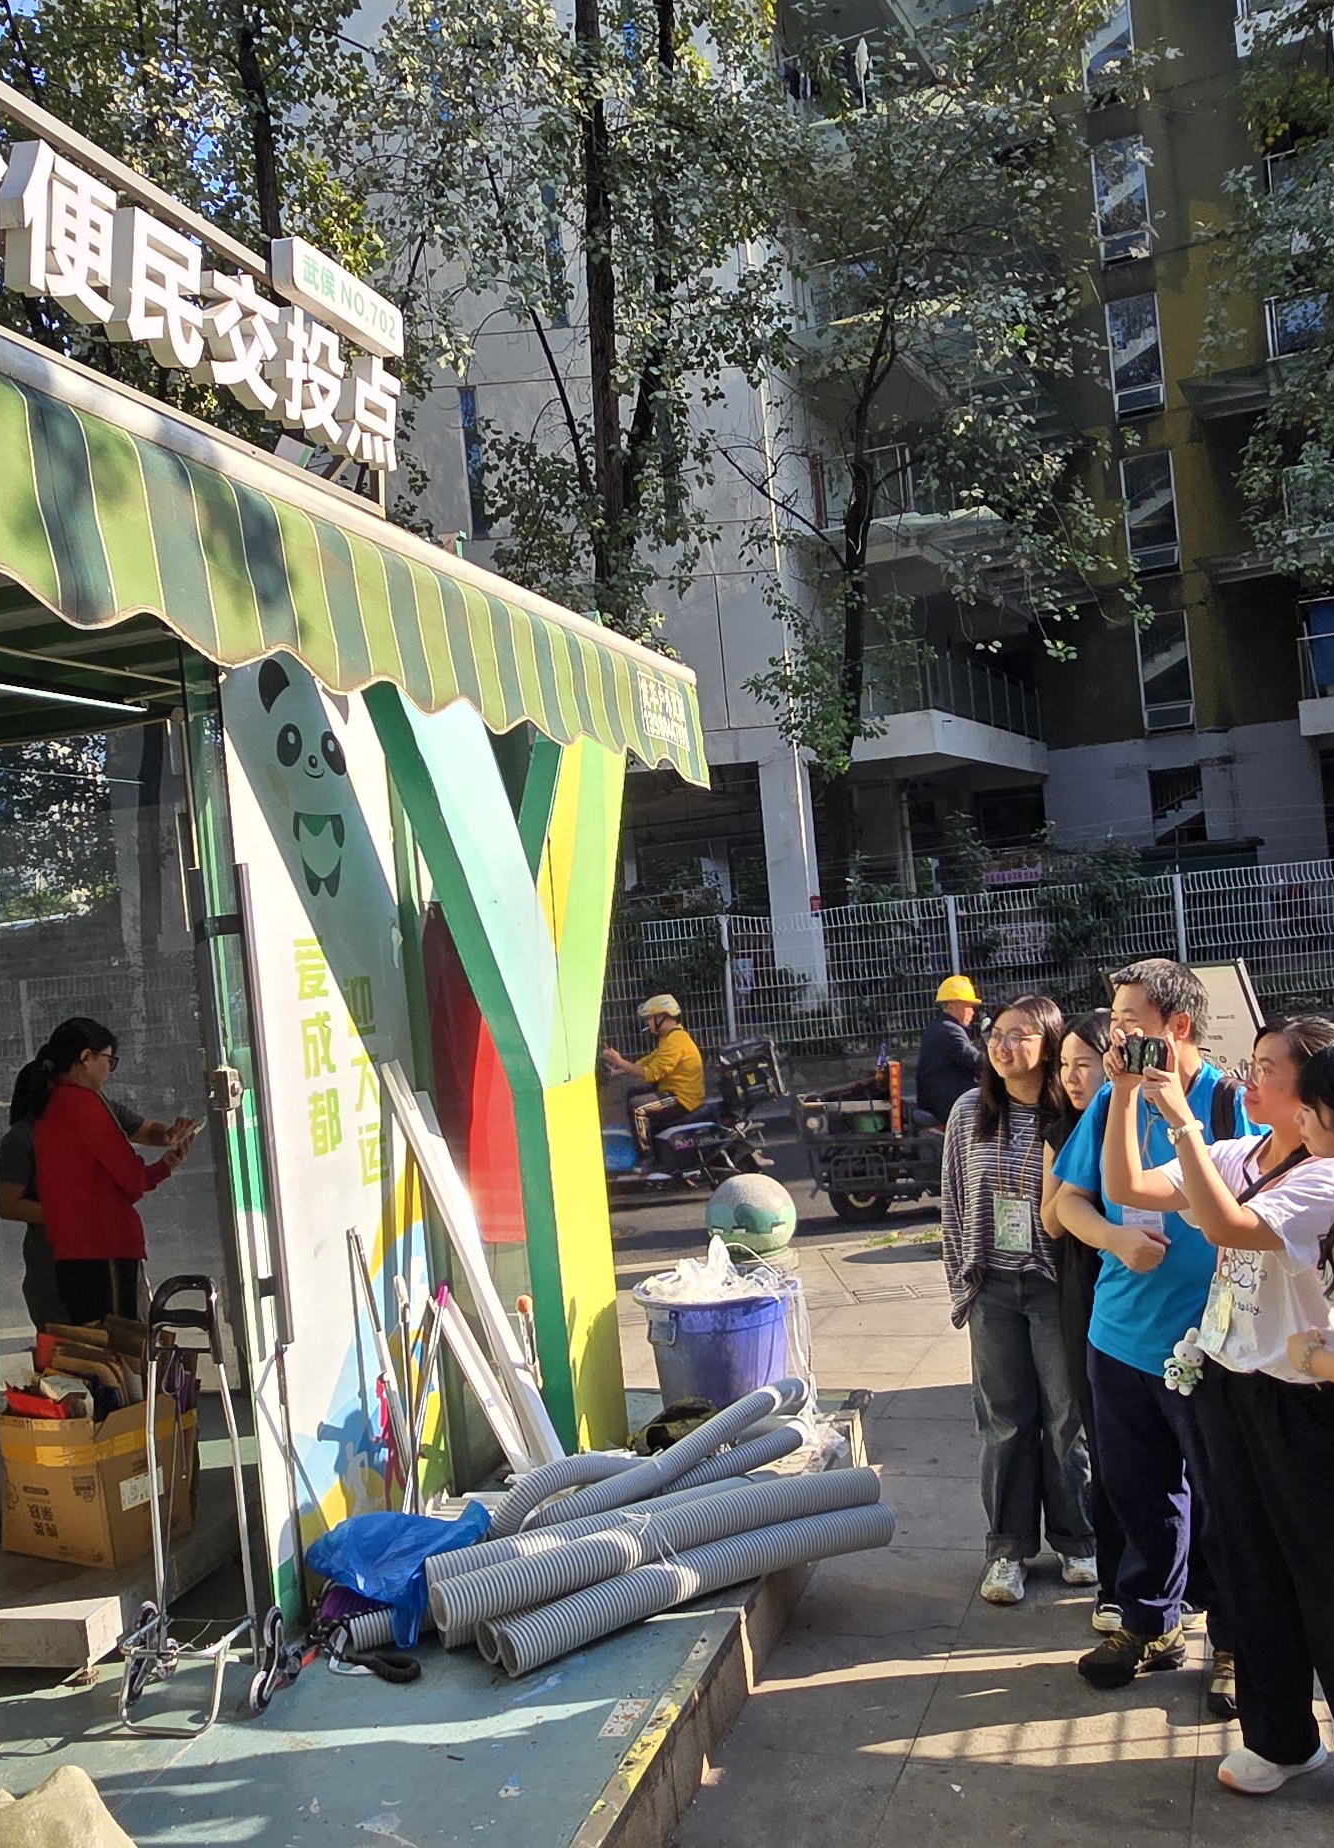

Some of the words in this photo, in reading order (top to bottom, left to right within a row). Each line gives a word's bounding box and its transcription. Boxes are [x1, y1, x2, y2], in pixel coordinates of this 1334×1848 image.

[302, 253, 336, 303] 武侯
[341, 280, 397, 341] NO.702
[293, 937, 343, 1158] 爱成都
[343, 976, 390, 1186] 迎大运
